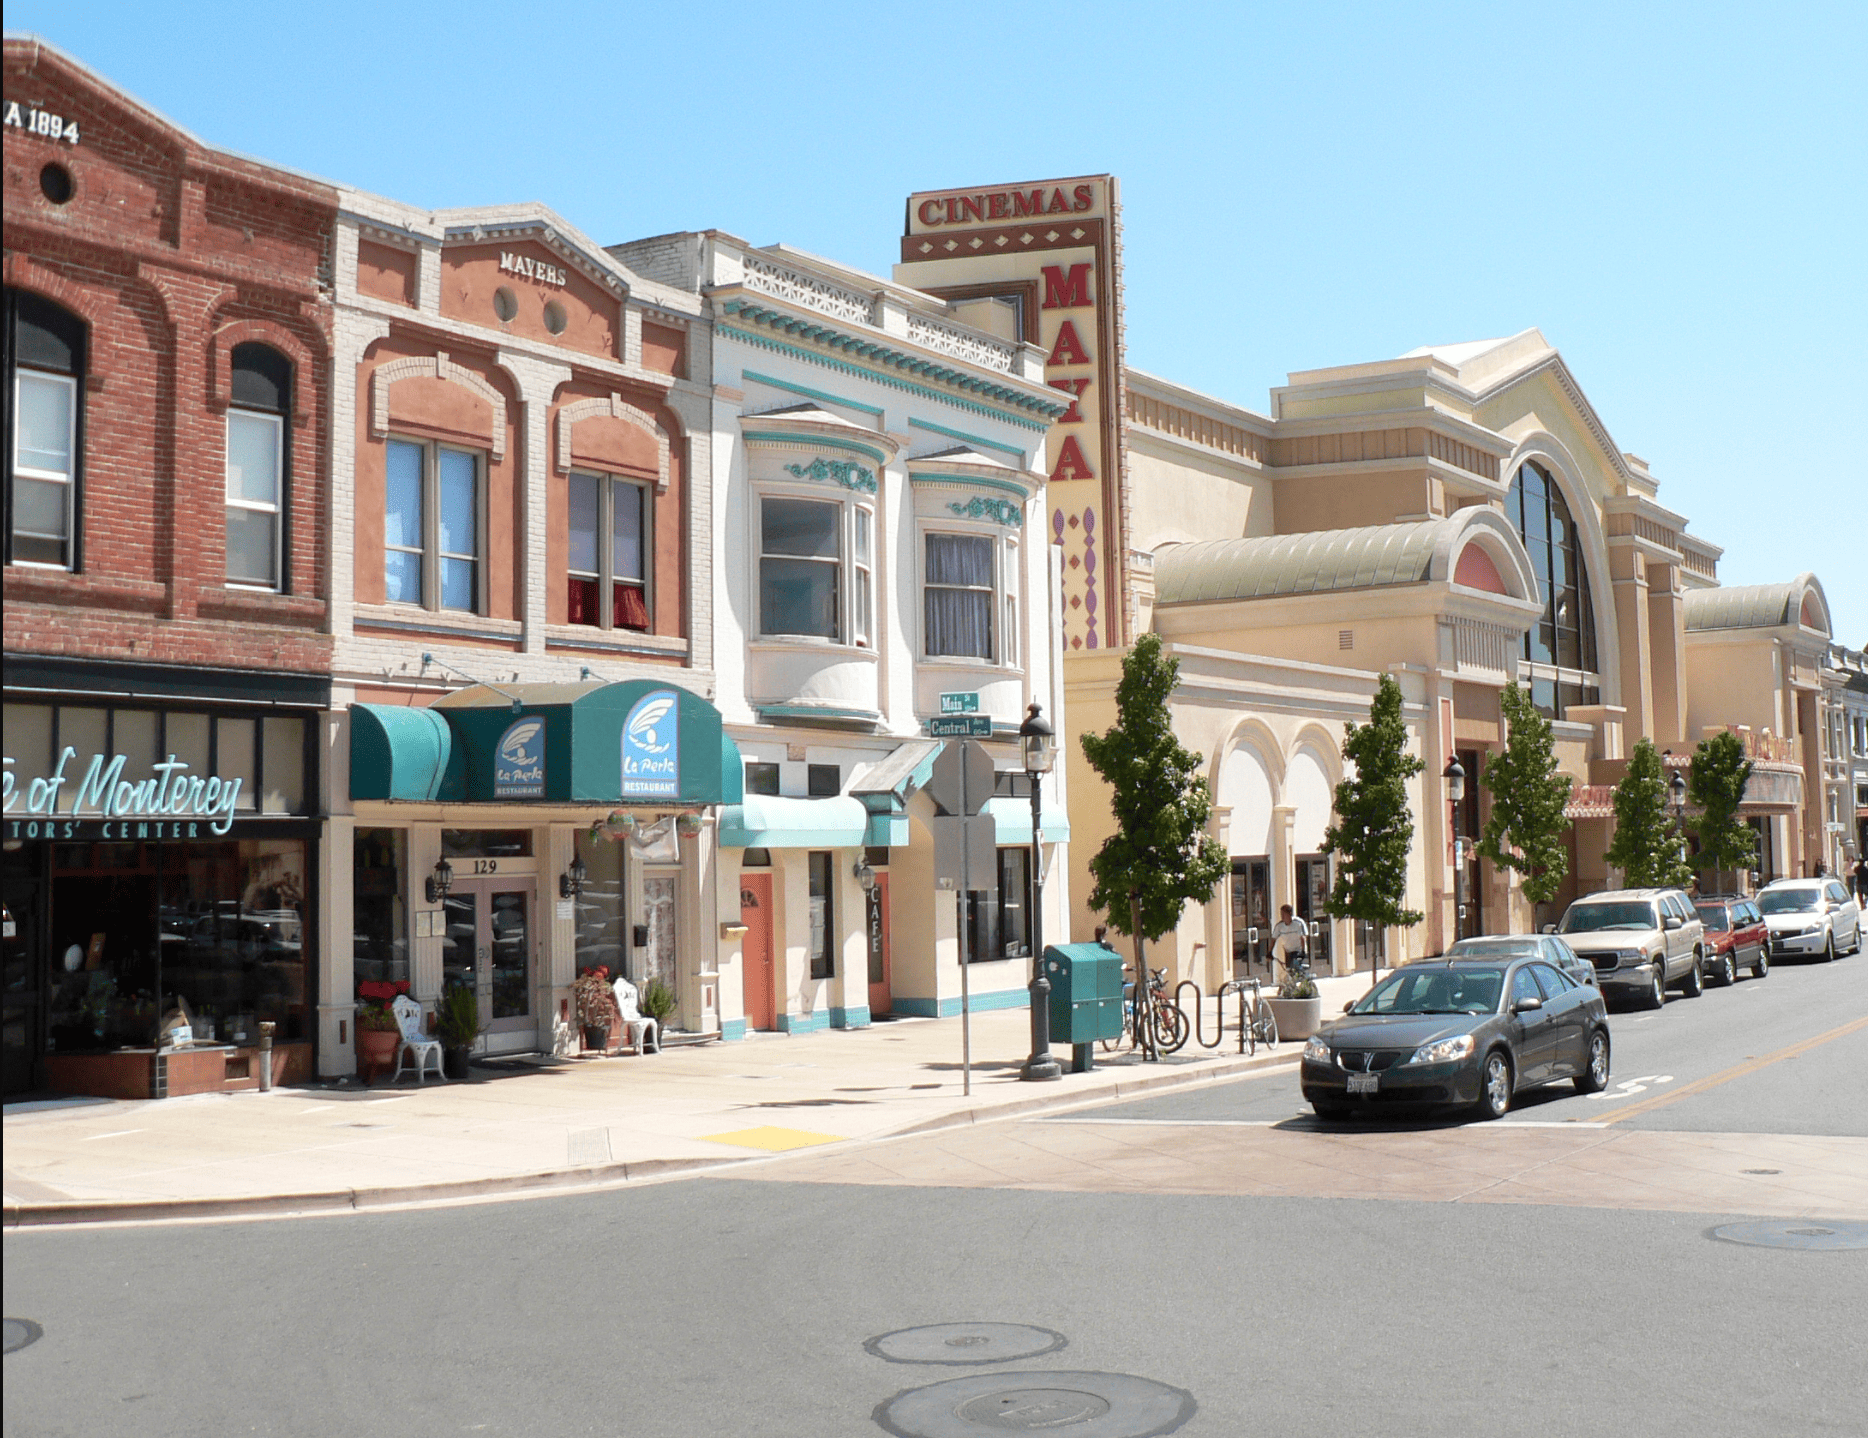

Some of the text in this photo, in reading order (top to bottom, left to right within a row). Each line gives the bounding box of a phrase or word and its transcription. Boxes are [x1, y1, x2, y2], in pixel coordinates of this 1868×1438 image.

[4, 102, 80, 145] A 1894
[918, 184, 1093, 226] CINEMAS
[500, 251, 567, 287] MAYERS
[1041, 263, 1094, 482] MAYA
[942, 696, 963, 711] Main
[931, 720, 971, 736] Central
[497, 766, 543, 783] La Perla
[624, 755, 675, 775] La Perla
[3, 746, 243, 836] e of Monterey
[624, 782, 676, 793] RESTAURANT
[101, 821, 198, 839] CENTER
[473, 859, 497, 875] 129
